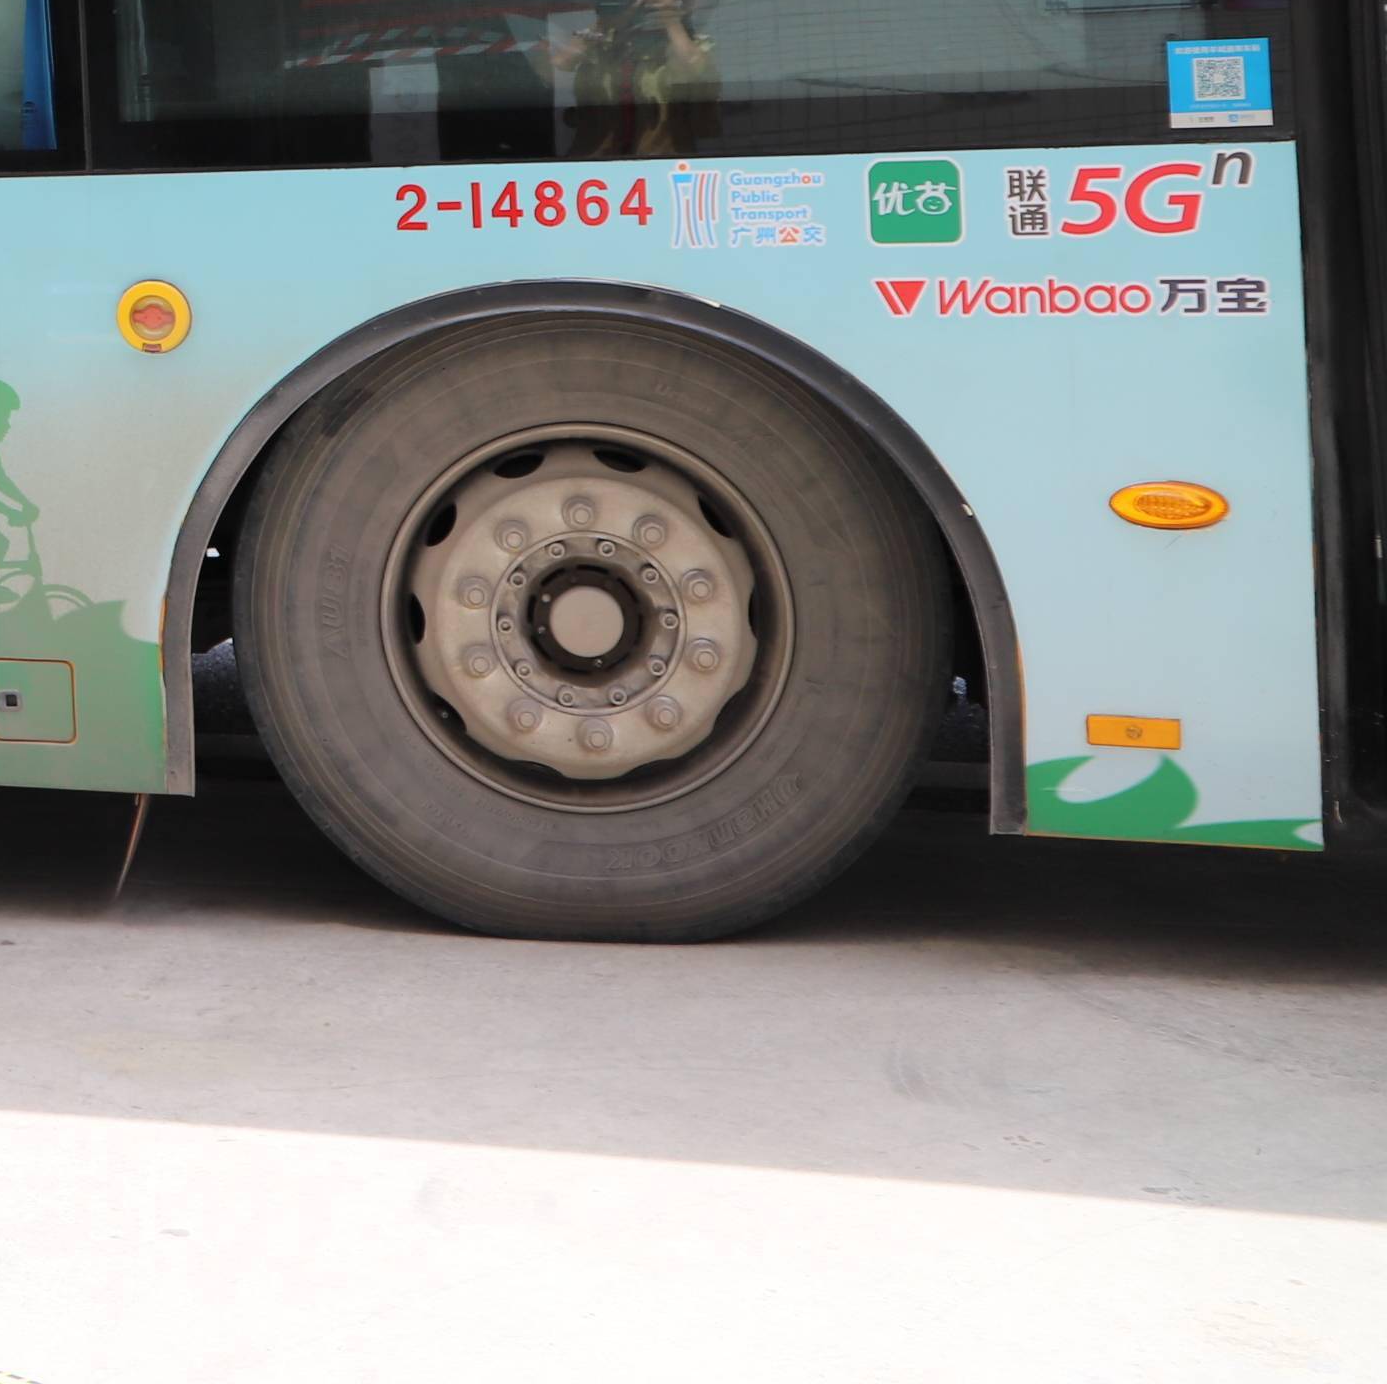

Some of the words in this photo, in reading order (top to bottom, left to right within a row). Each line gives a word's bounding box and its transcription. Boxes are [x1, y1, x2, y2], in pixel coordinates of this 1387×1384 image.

[729, 171, 823, 189] Guangzhou
[395, 177, 654, 232] 2-14864
[730, 190, 781, 204] Public
[1007, 168, 1049, 237] 联通
[731, 206, 809, 222] Transport
[730, 225, 825, 246] 广州公交
[938, 279, 1152, 315] Wanbao
[1159, 277, 1268, 315] 万宝
